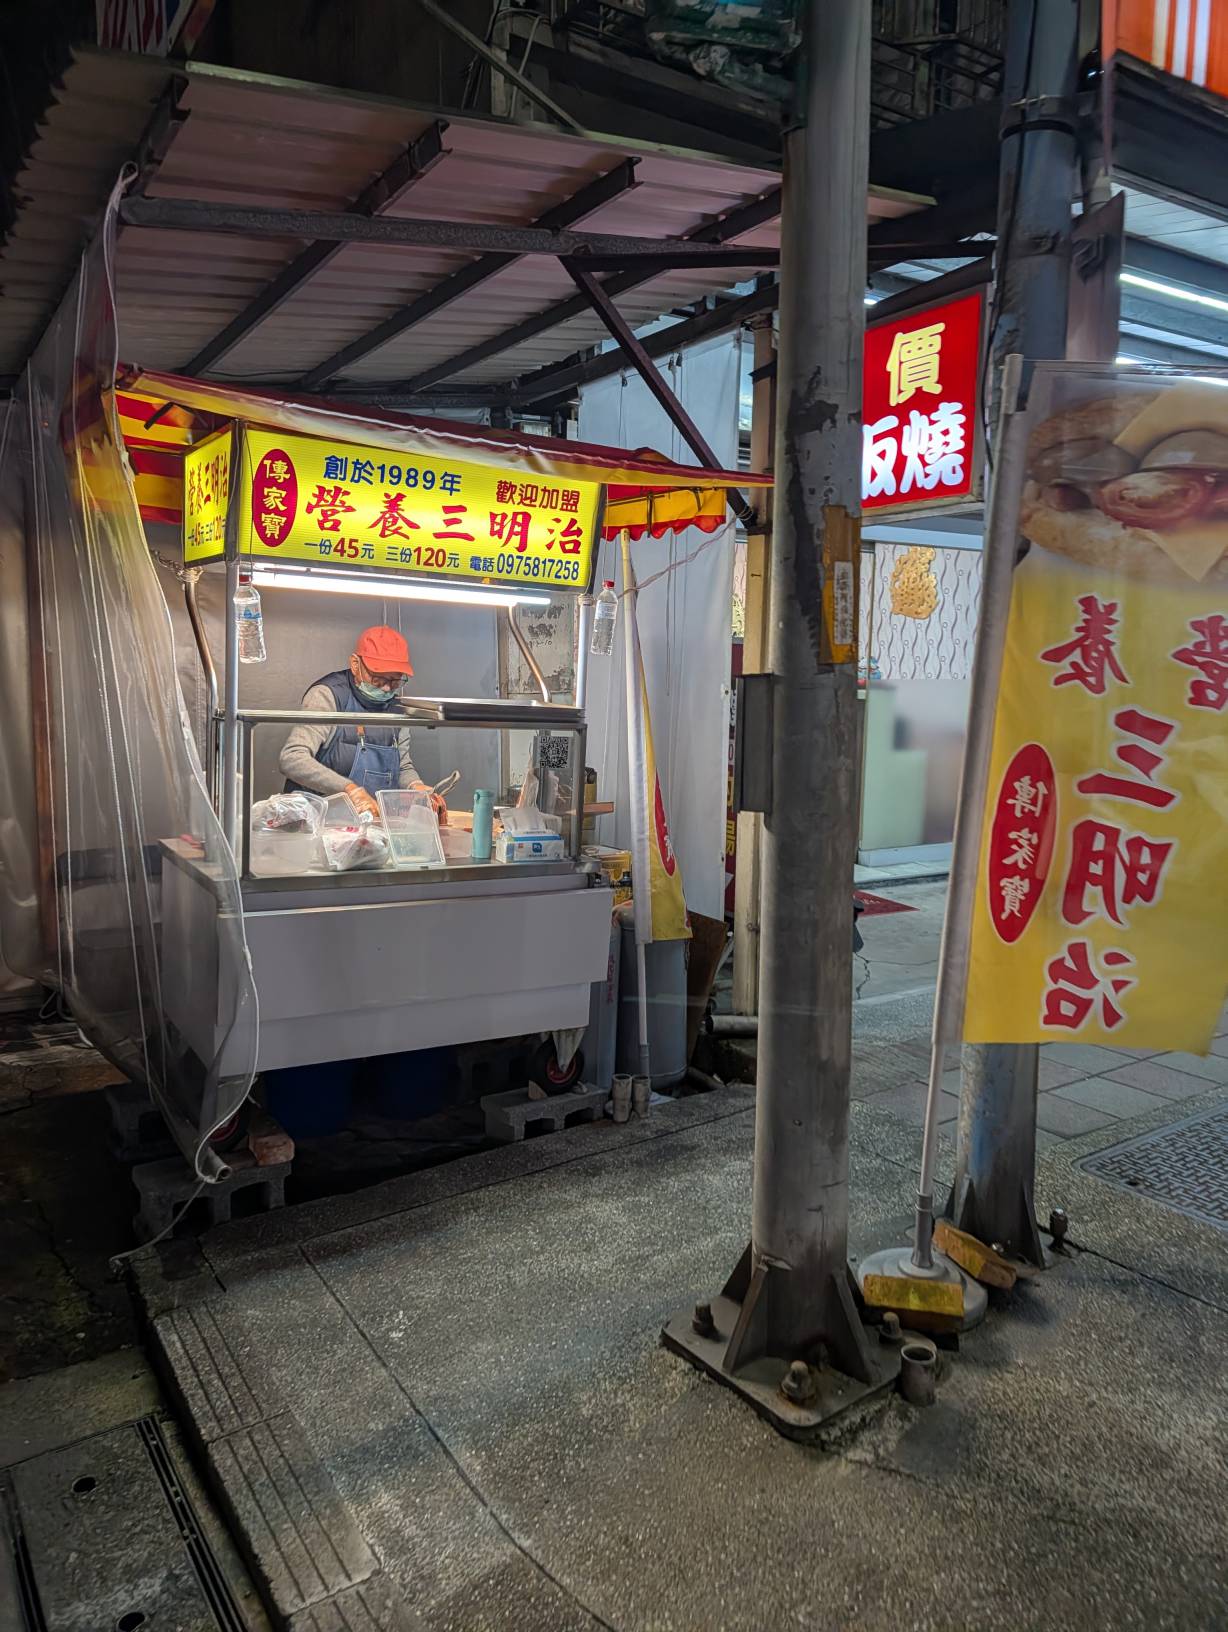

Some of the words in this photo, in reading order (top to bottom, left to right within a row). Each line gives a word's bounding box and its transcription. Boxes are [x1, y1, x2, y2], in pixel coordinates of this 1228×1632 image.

[885, 322, 945, 407] 價
[261, 459, 291, 539] 傳家寶
[323, 455, 462, 496] 創於1989年
[496, 480, 580, 513] 歡迎加盟
[305, 484, 583, 554] 營養三明治
[304, 537, 375, 559] 一份45元
[385, 546, 459, 568] 三份120元
